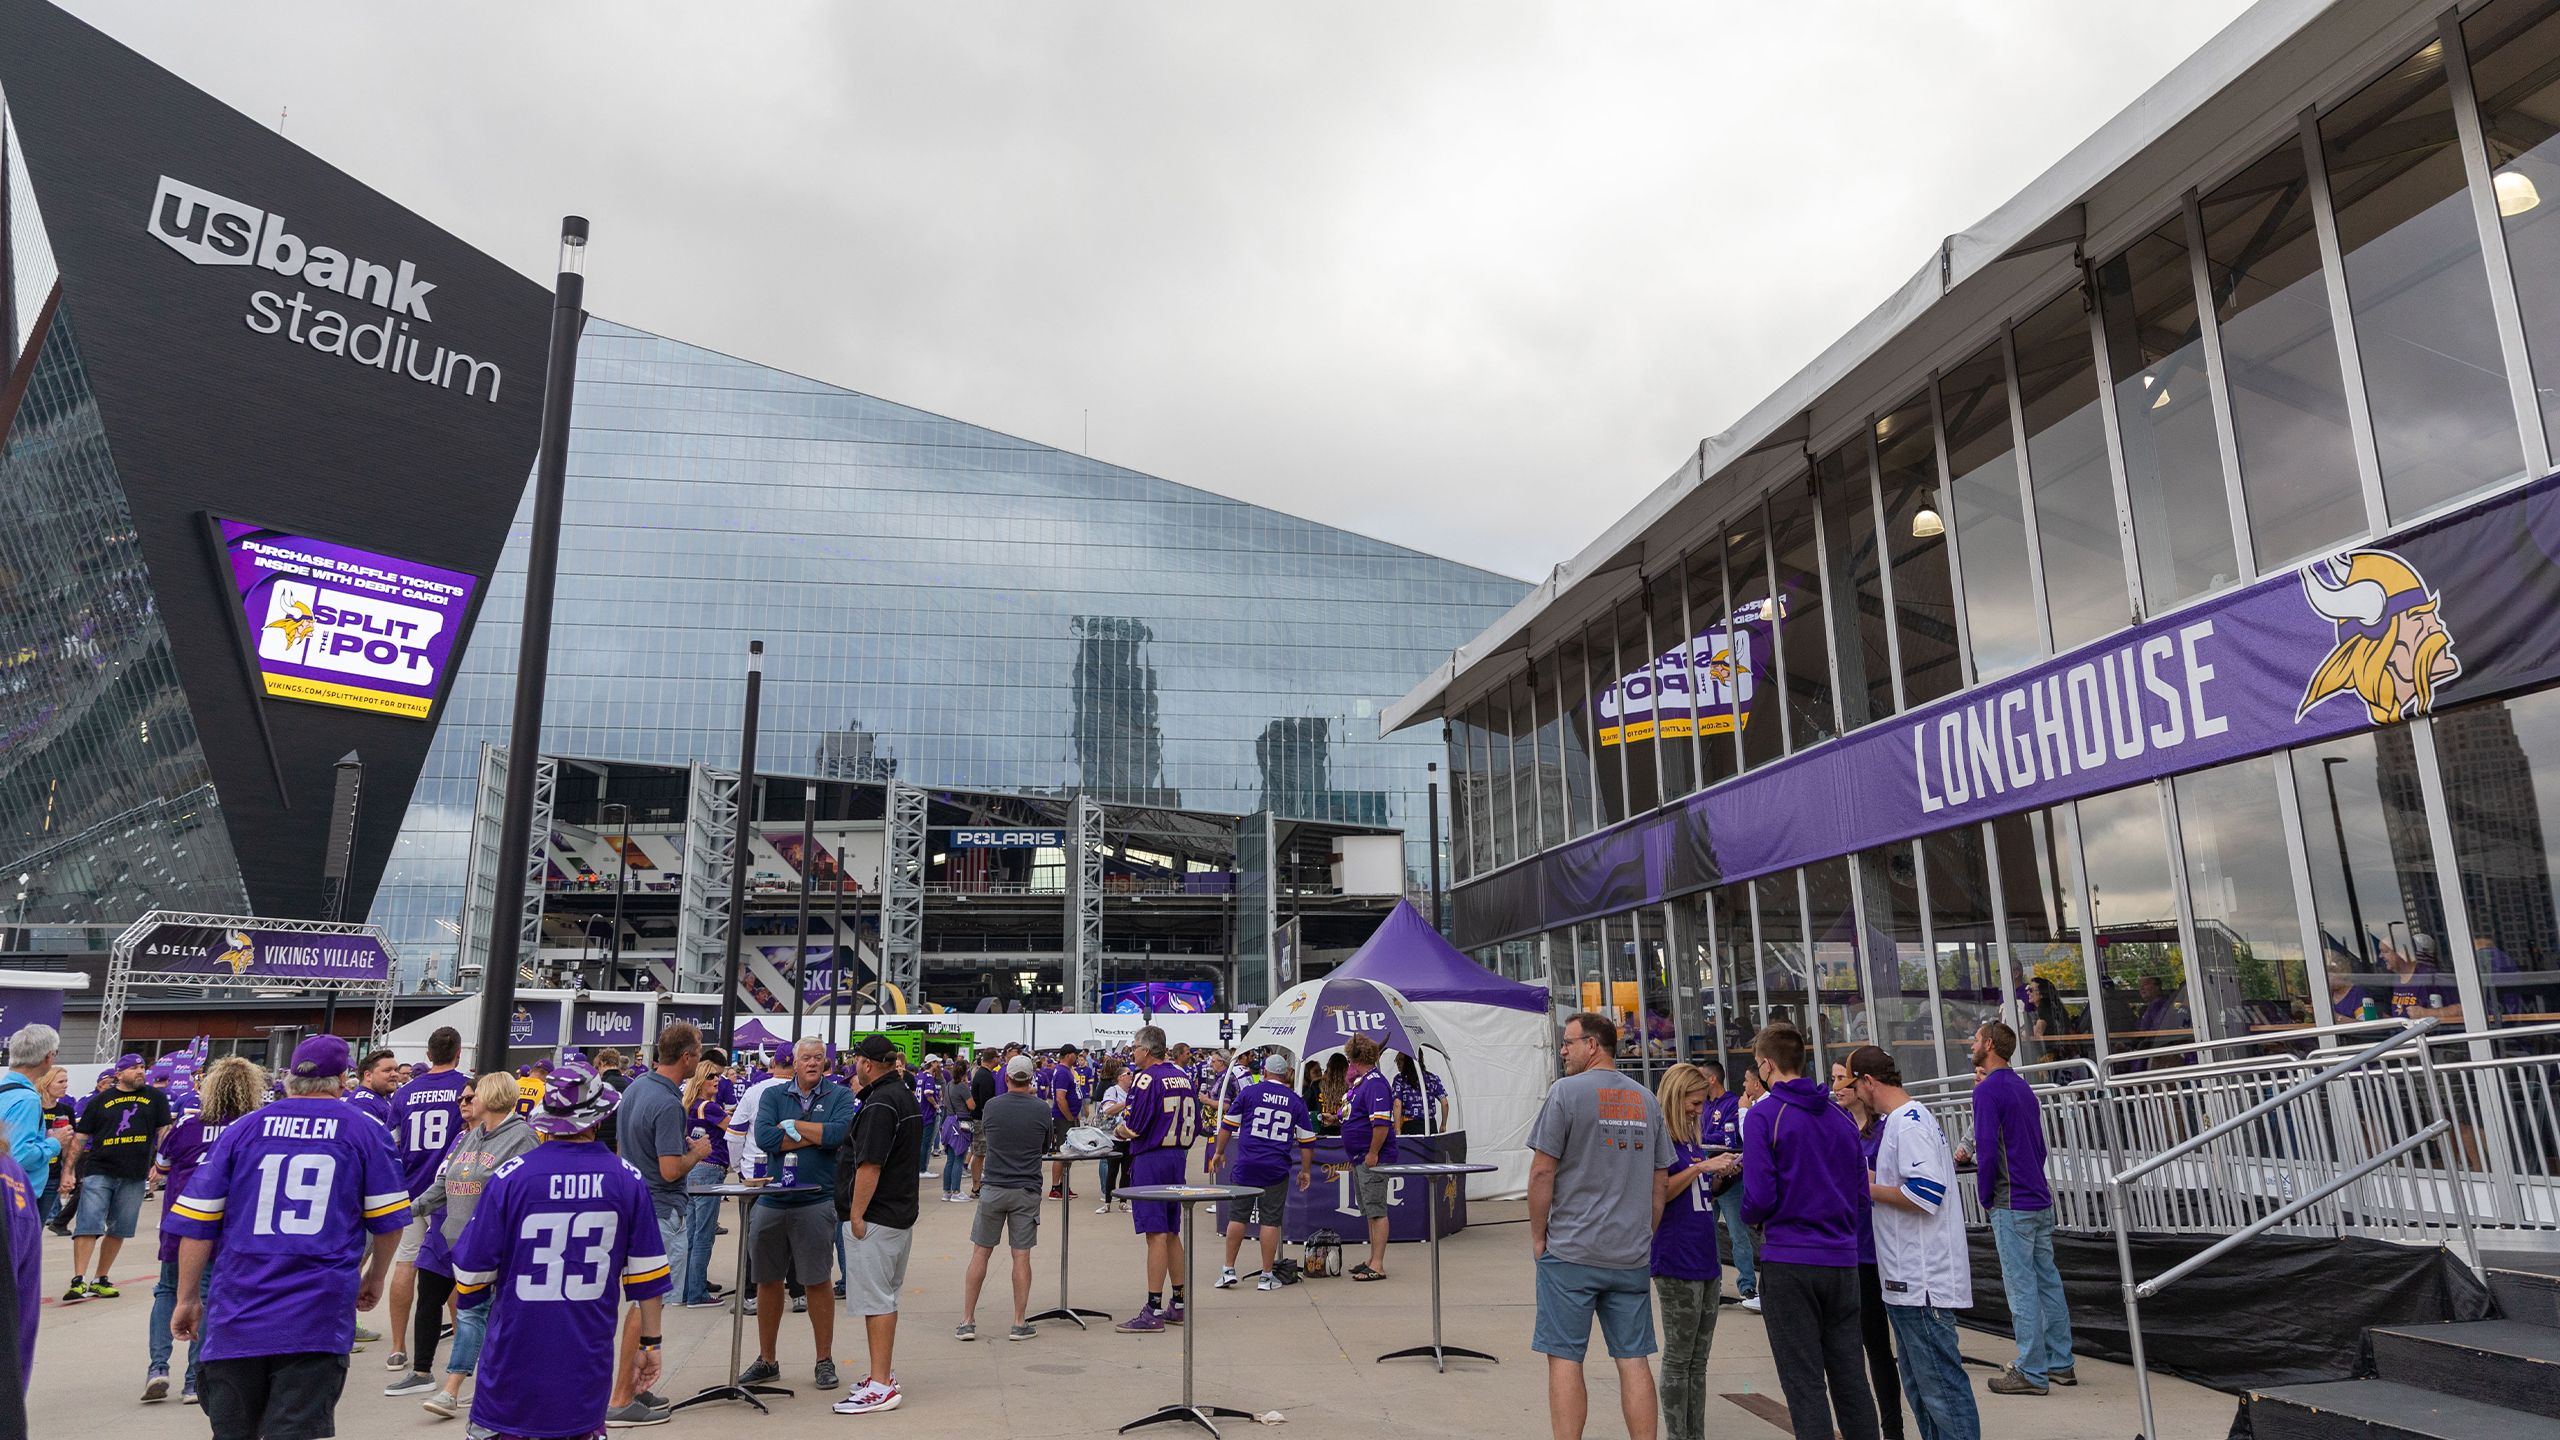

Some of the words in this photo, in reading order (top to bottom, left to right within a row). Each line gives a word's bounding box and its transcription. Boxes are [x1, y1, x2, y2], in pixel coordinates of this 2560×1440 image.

[246, 291, 501, 403] stadium
[242, 540, 335, 569] PURCHASE
[337, 561, 397, 583] RAFFLE
[400, 576, 464, 597] TICKETS
[254, 556, 310, 577] INSIDE
[312, 569, 352, 585] WITH
[354, 577, 400, 595] DEBIT
[401, 588, 449, 606] CARD!
[315, 605, 418, 640] SPLIT
[319, 630, 330, 653] THE
[329, 632, 428, 670] POT
[268, 681, 379, 706] VIKINGS.COM/SPLITTHEPOT
[380, 699, 396, 708] FOR
[397, 702, 427, 713] DETAILS
[1914, 619, 2229, 813] LONGHOUSE
[957, 832, 1056, 846] POLARIS
[161, 944, 207, 957] DELTA
[264, 945, 319, 966] VIKINGS
[323, 948, 376, 969] VILLAGE
[692, 1017, 715, 1030] Dental
[1271, 1026, 1297, 1035] TEAM
[1334, 1009, 1386, 1036] Lite
[407, 1089, 457, 1105] JEFFERSON
[1262, 1092, 1289, 1107] SMITH
[262, 1116, 339, 1140] THIELEN
[408, 1110, 449, 1151] 18
[1161, 1096, 1196, 1147] 78
[1250, 1106, 1292, 1142] 22
[1904, 1108, 1921, 1122] 4
[253, 1154, 336, 1235] 19
[550, 1173, 605, 1200] COOK
[1335, 1171, 1404, 1218] Le
[515, 1211, 619, 1302] 33
